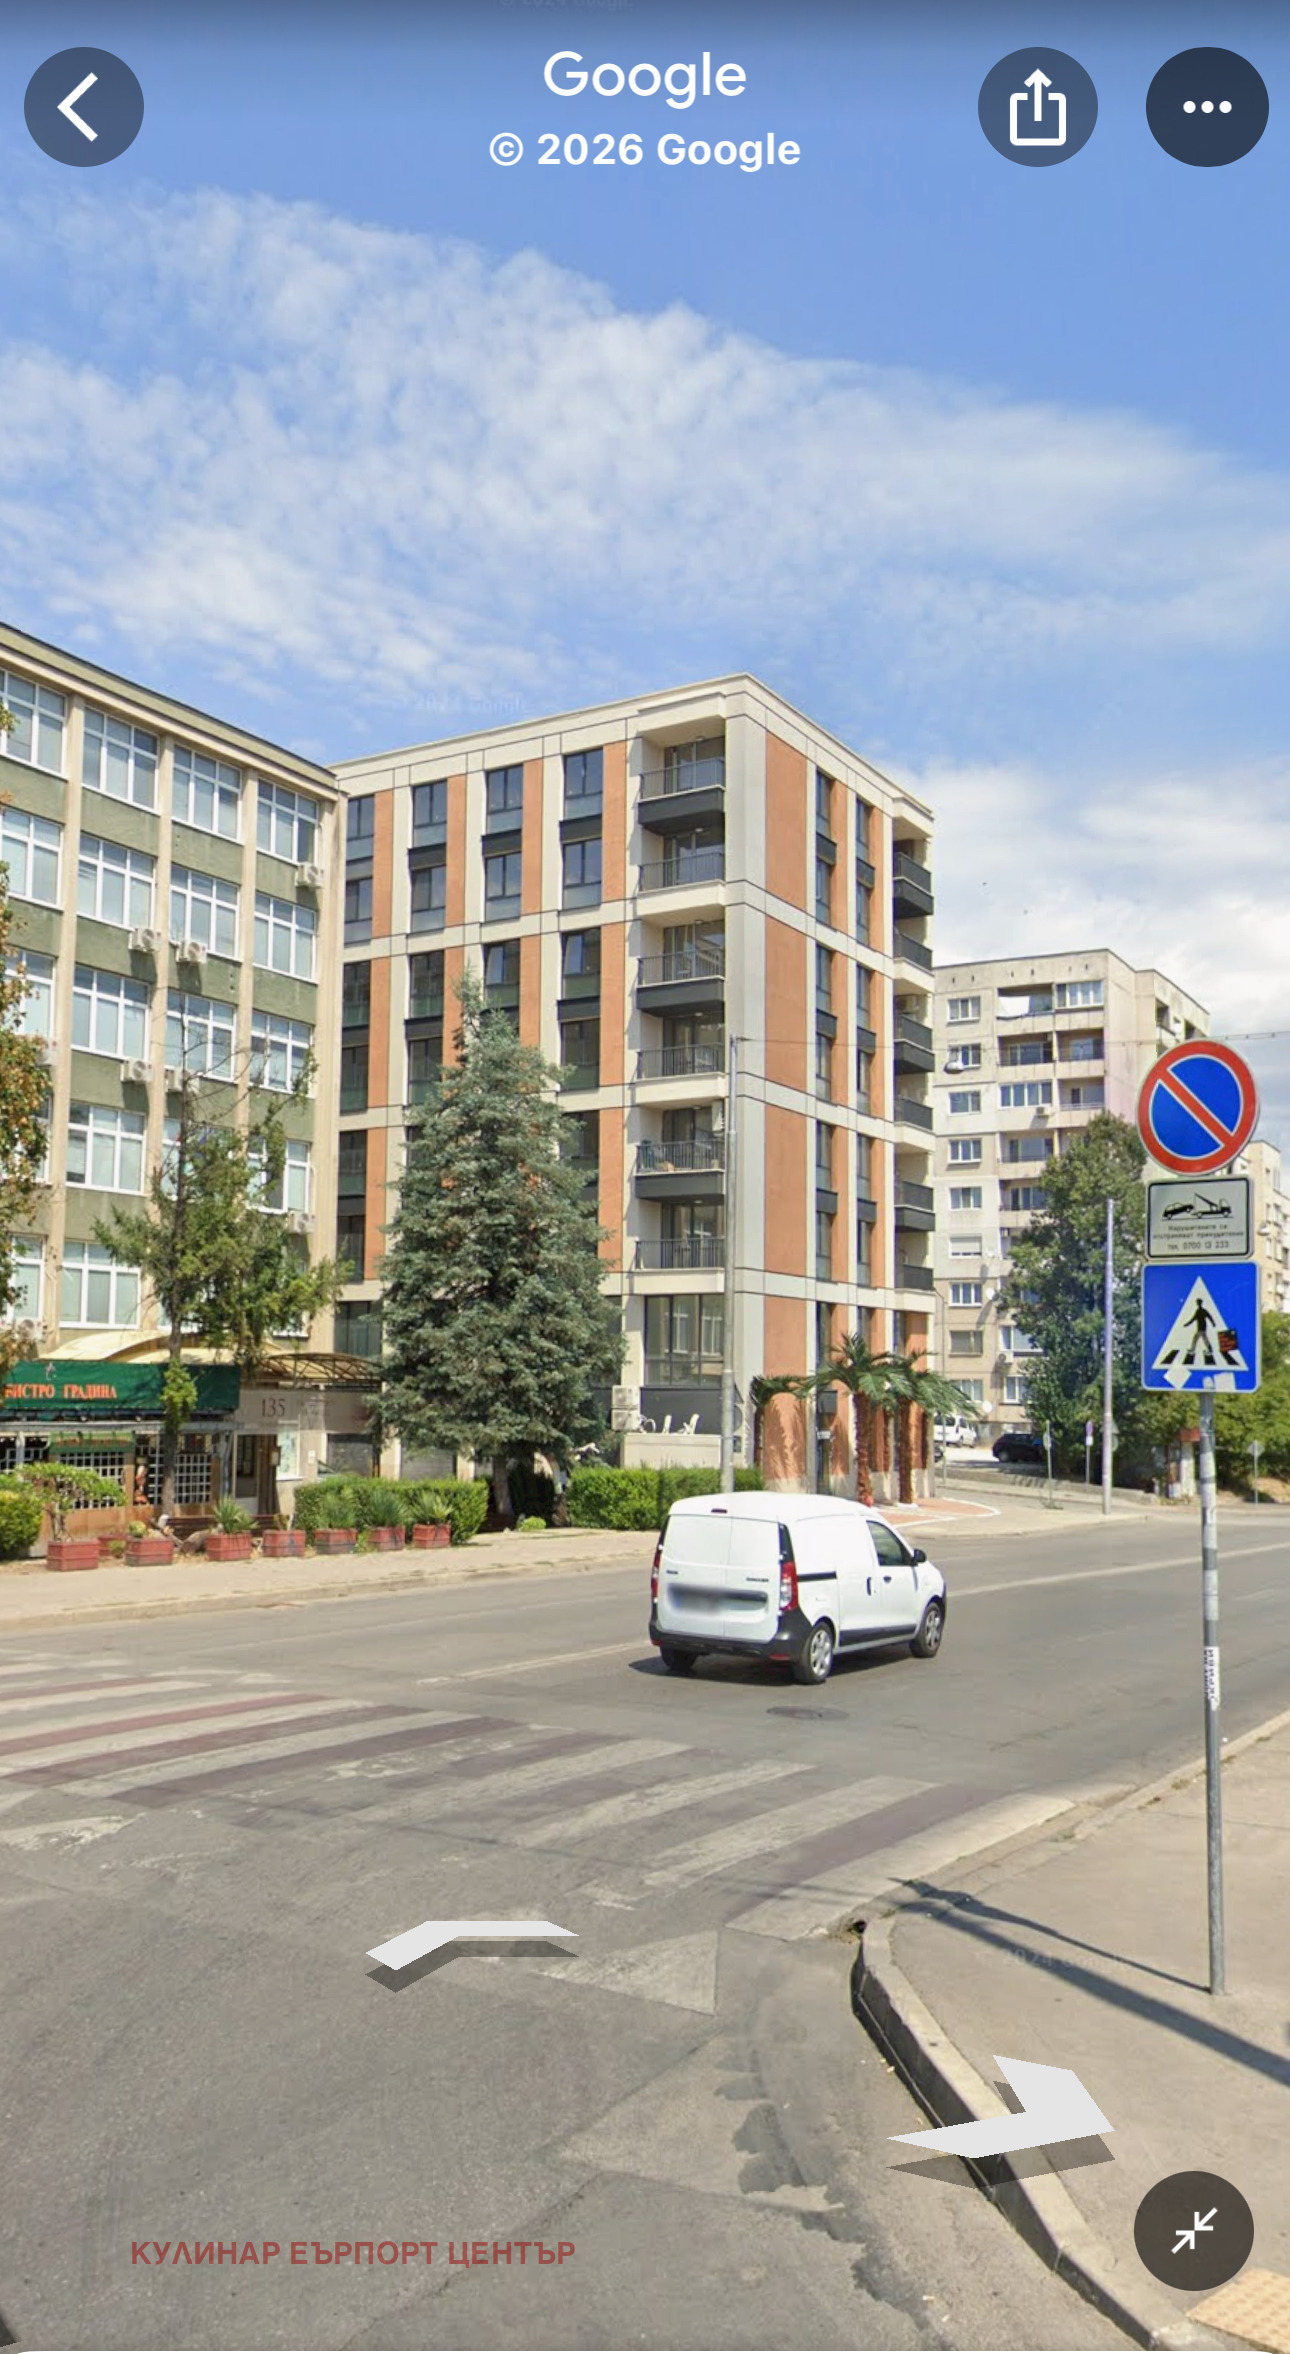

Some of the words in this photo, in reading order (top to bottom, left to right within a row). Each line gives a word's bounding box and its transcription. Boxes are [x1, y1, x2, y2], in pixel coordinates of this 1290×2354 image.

[5, 1383, 56, 1399] БИСТРО
[63, 1383, 117, 1400] ГРАДИНА
[261, 1399, 286, 1418] 135
